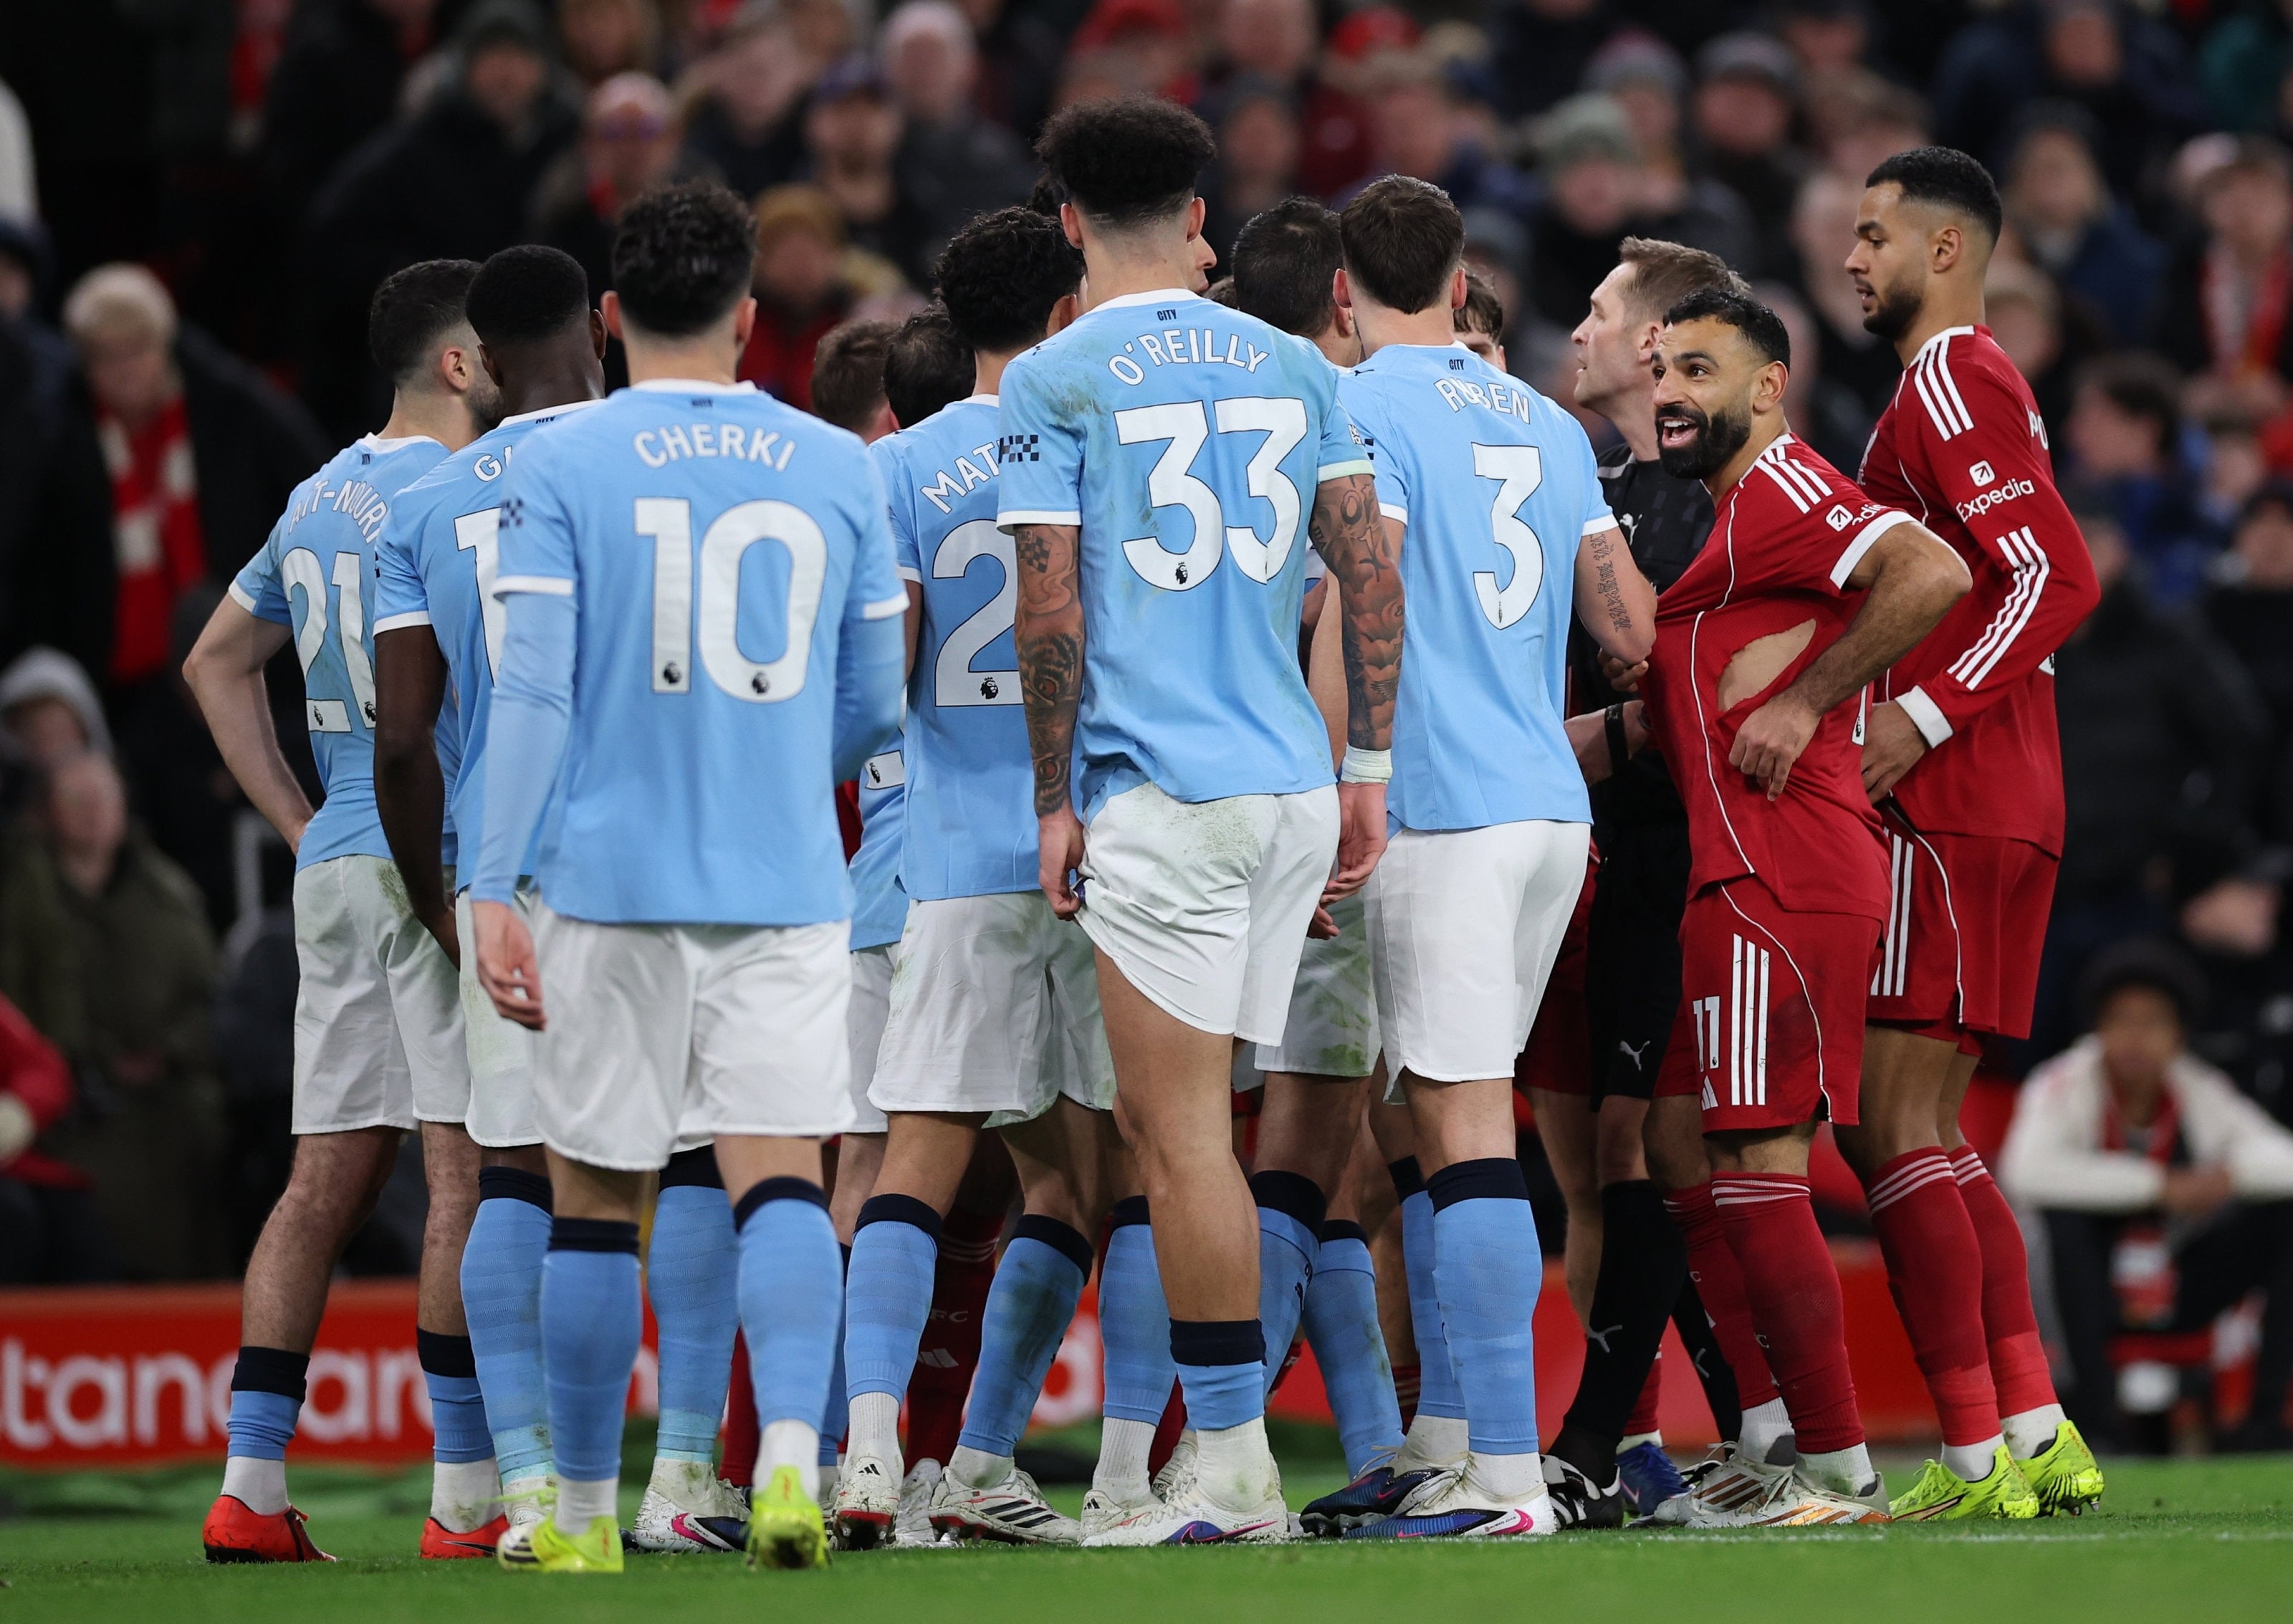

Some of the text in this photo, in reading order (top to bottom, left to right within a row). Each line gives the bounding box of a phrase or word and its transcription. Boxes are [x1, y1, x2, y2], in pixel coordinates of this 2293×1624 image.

[1157, 309, 1177, 321] CITY
[1108, 329, 1270, 385] O'REILLY
[1449, 359, 1464, 370] CITY
[633, 422, 796, 472] CHERKI
[920, 439, 1000, 514] MAT
[1114, 396, 1308, 592] 33
[1955, 478, 2035, 523] Expedia
[1471, 442, 1543, 630] 3
[634, 496, 828, 703] 10
[282, 547, 377, 733] 21
[1693, 996, 1720, 1072] 11
